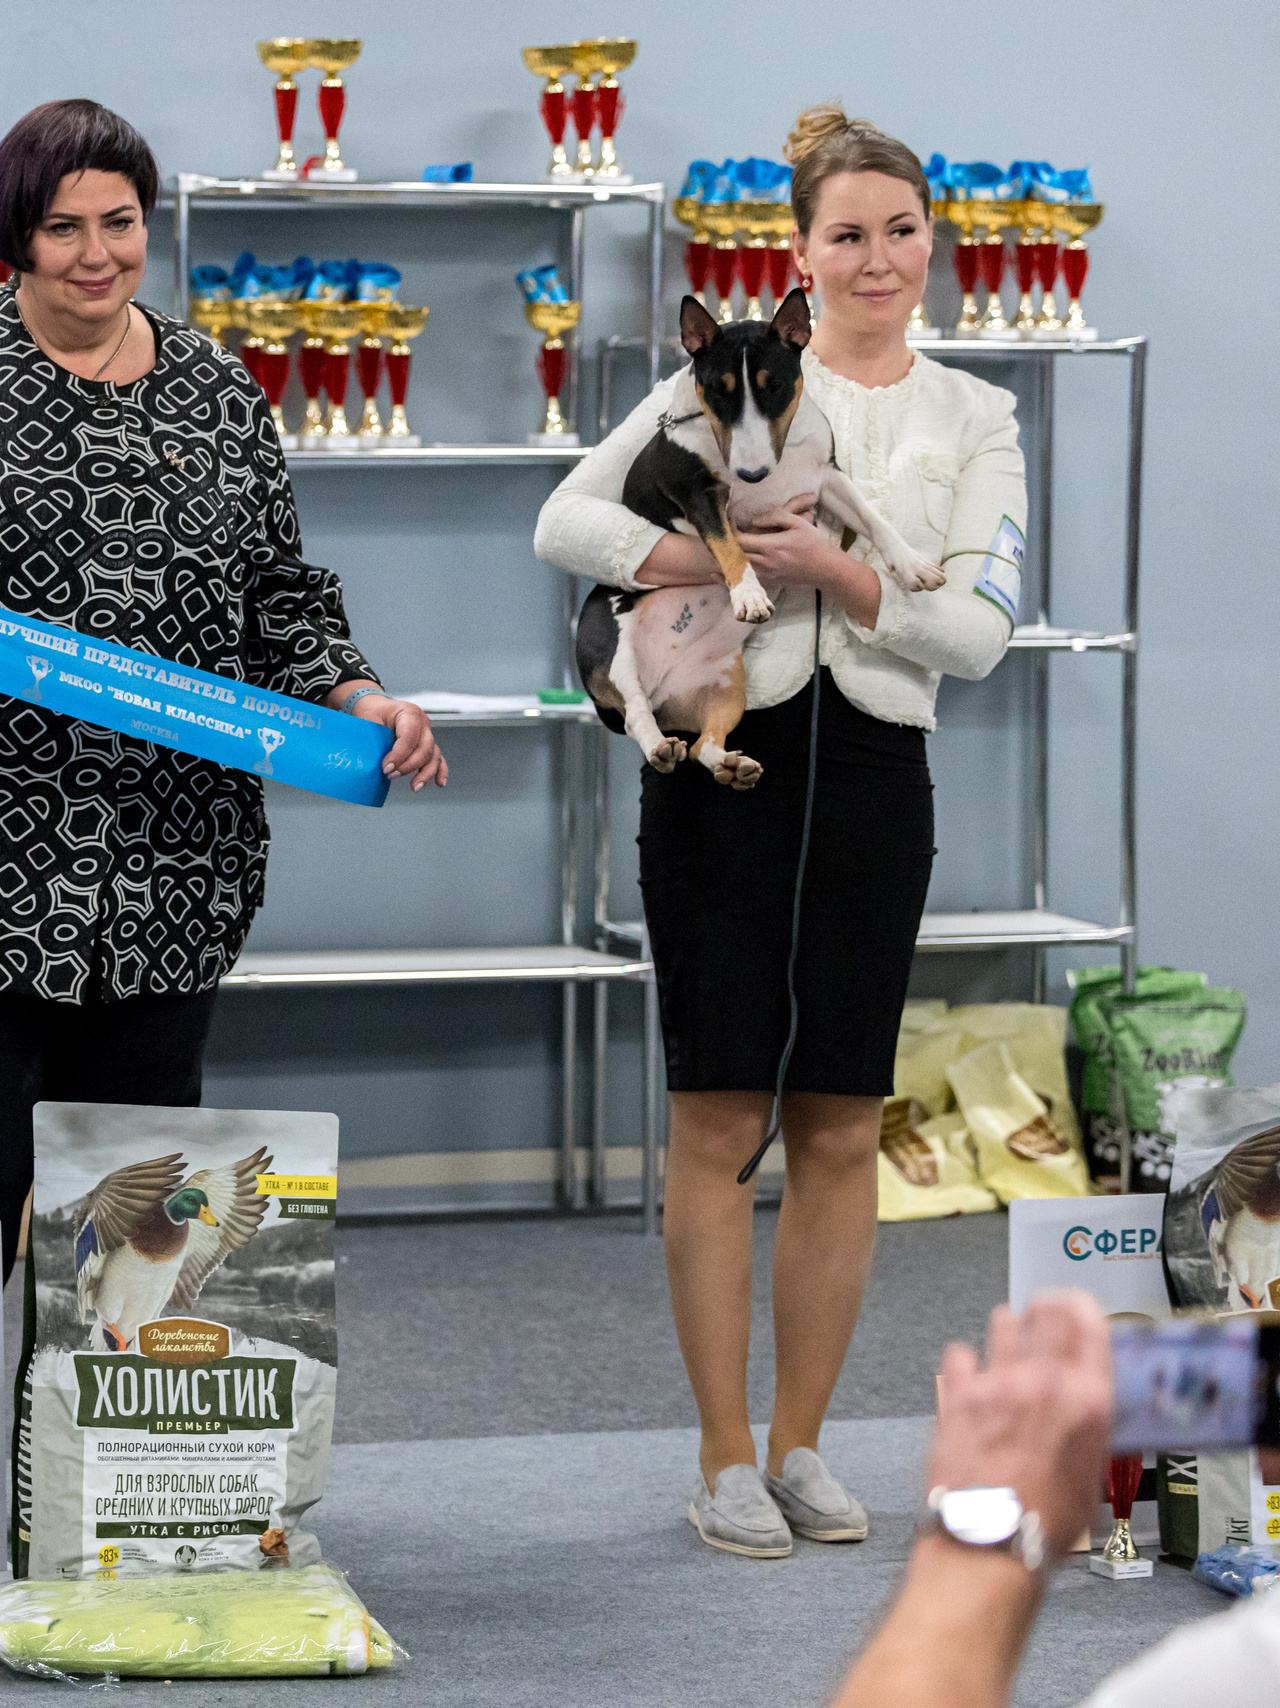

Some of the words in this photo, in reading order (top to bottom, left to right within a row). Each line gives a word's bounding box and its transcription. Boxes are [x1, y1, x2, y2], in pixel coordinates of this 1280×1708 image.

[83, 644, 237, 706] ПРЕДСТАВИТЕЛЬ
[59, 670, 103, 694] МКОО
[107, 685, 161, 713] "НОВАЯ
[165, 703, 252, 739] КЛАССИКА"
[130, 718, 179, 743] МОСКВА
[264, 1180, 280, 1190] УТКА
[304, 1181, 329, 1191] СОСТАВЕ
[287, 1203, 300, 1214] БЕЗ
[300, 1204, 329, 1214] ГЛЮТЕНА
[1062, 1225, 1162, 1262] СФЕР
[147, 1328, 220, 1345] Деревенские
[152, 1341, 217, 1353] лакомства
[92, 1364, 281, 1421] ХОЛИСТИК
[156, 1421, 221, 1432] ПРЕМЬЕР
[97, 1441, 205, 1454] ПОЛНОРАЦИОННЫЙ
[208, 1441, 244, 1453] СУХОЙ
[247, 1442, 276, 1453] КОРМ
[114, 1473, 142, 1495] ДЛЯ
[147, 1473, 215, 1494] ВЗРОСЛЫХ
[219, 1473, 259, 1494] СОБАК
[95, 1496, 154, 1518] СРЕДНИХ
[157, 1497, 166, 1516] И
[170, 1497, 231, 1517] КРУПНЫХ
[233, 1496, 274, 1517] ПОРОД
[129, 1524, 169, 1536] УТКА
[176, 1525, 185, 1536] С
[192, 1523, 241, 1536] РИСОМ
[98, 1548, 119, 1563] >83%
